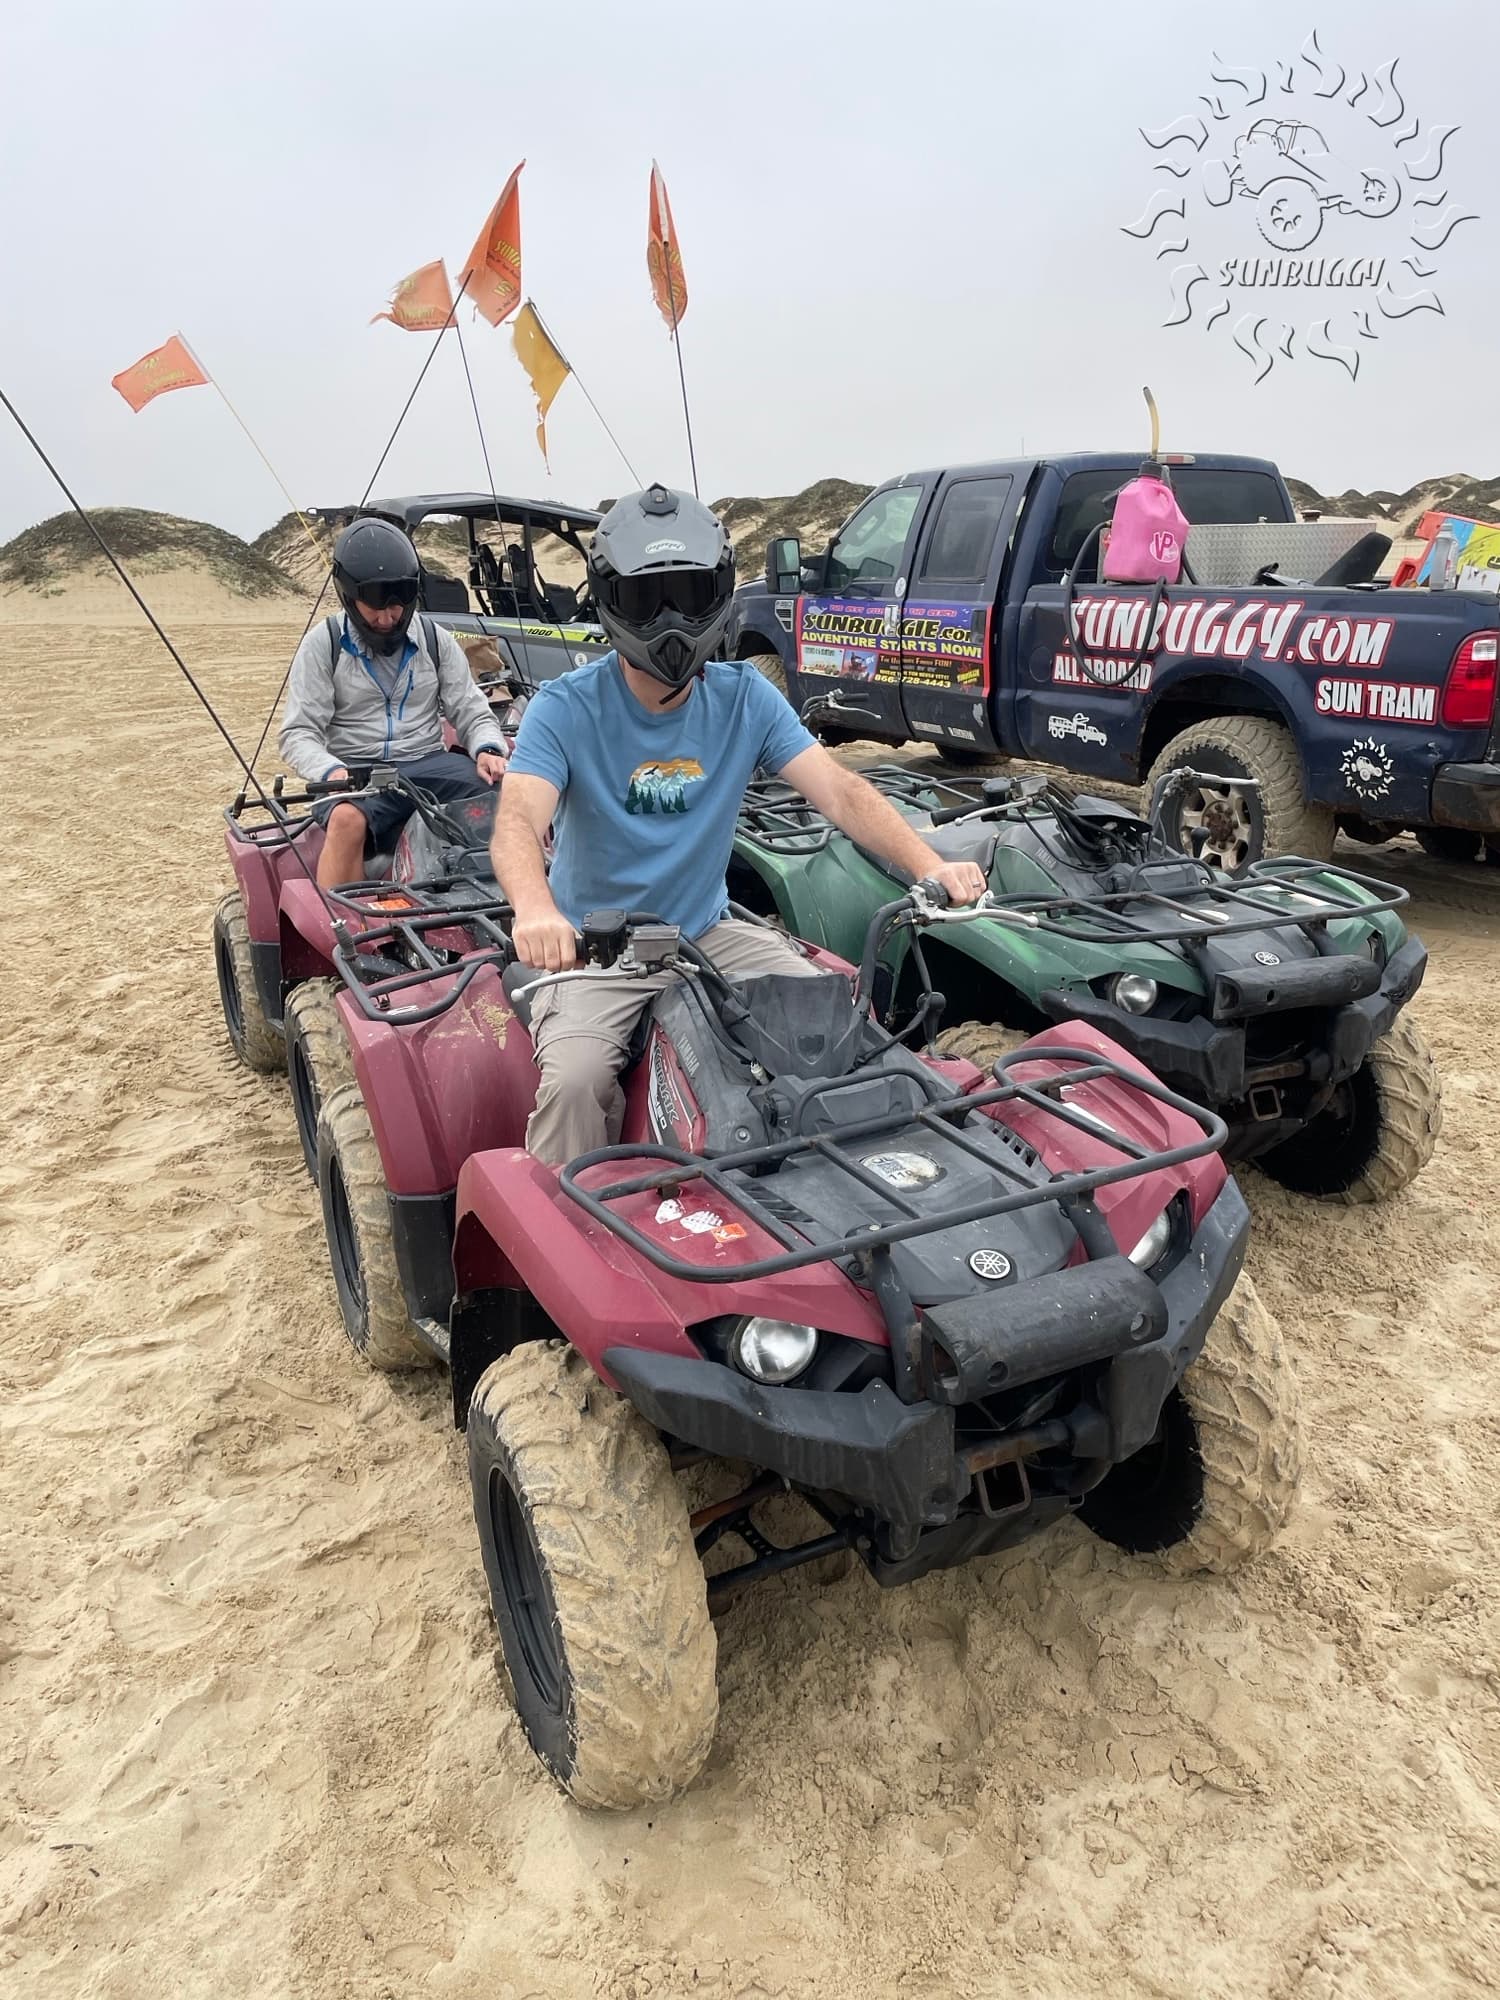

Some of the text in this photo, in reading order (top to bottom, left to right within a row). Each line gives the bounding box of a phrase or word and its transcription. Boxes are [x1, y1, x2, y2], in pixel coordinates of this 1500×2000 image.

[1152, 532, 1175, 561] VP
[527, 628, 553, 637] 1000
[801, 631, 982, 659] ADVENTURE STARTS NOW!
[1064, 598, 1393, 666] SUNBUGGY.COM
[1054, 655, 1152, 690] ALL ABOARD
[1317, 679, 1436, 721] SUN TRAM
[677, 1033, 700, 1077] YAMAHA
